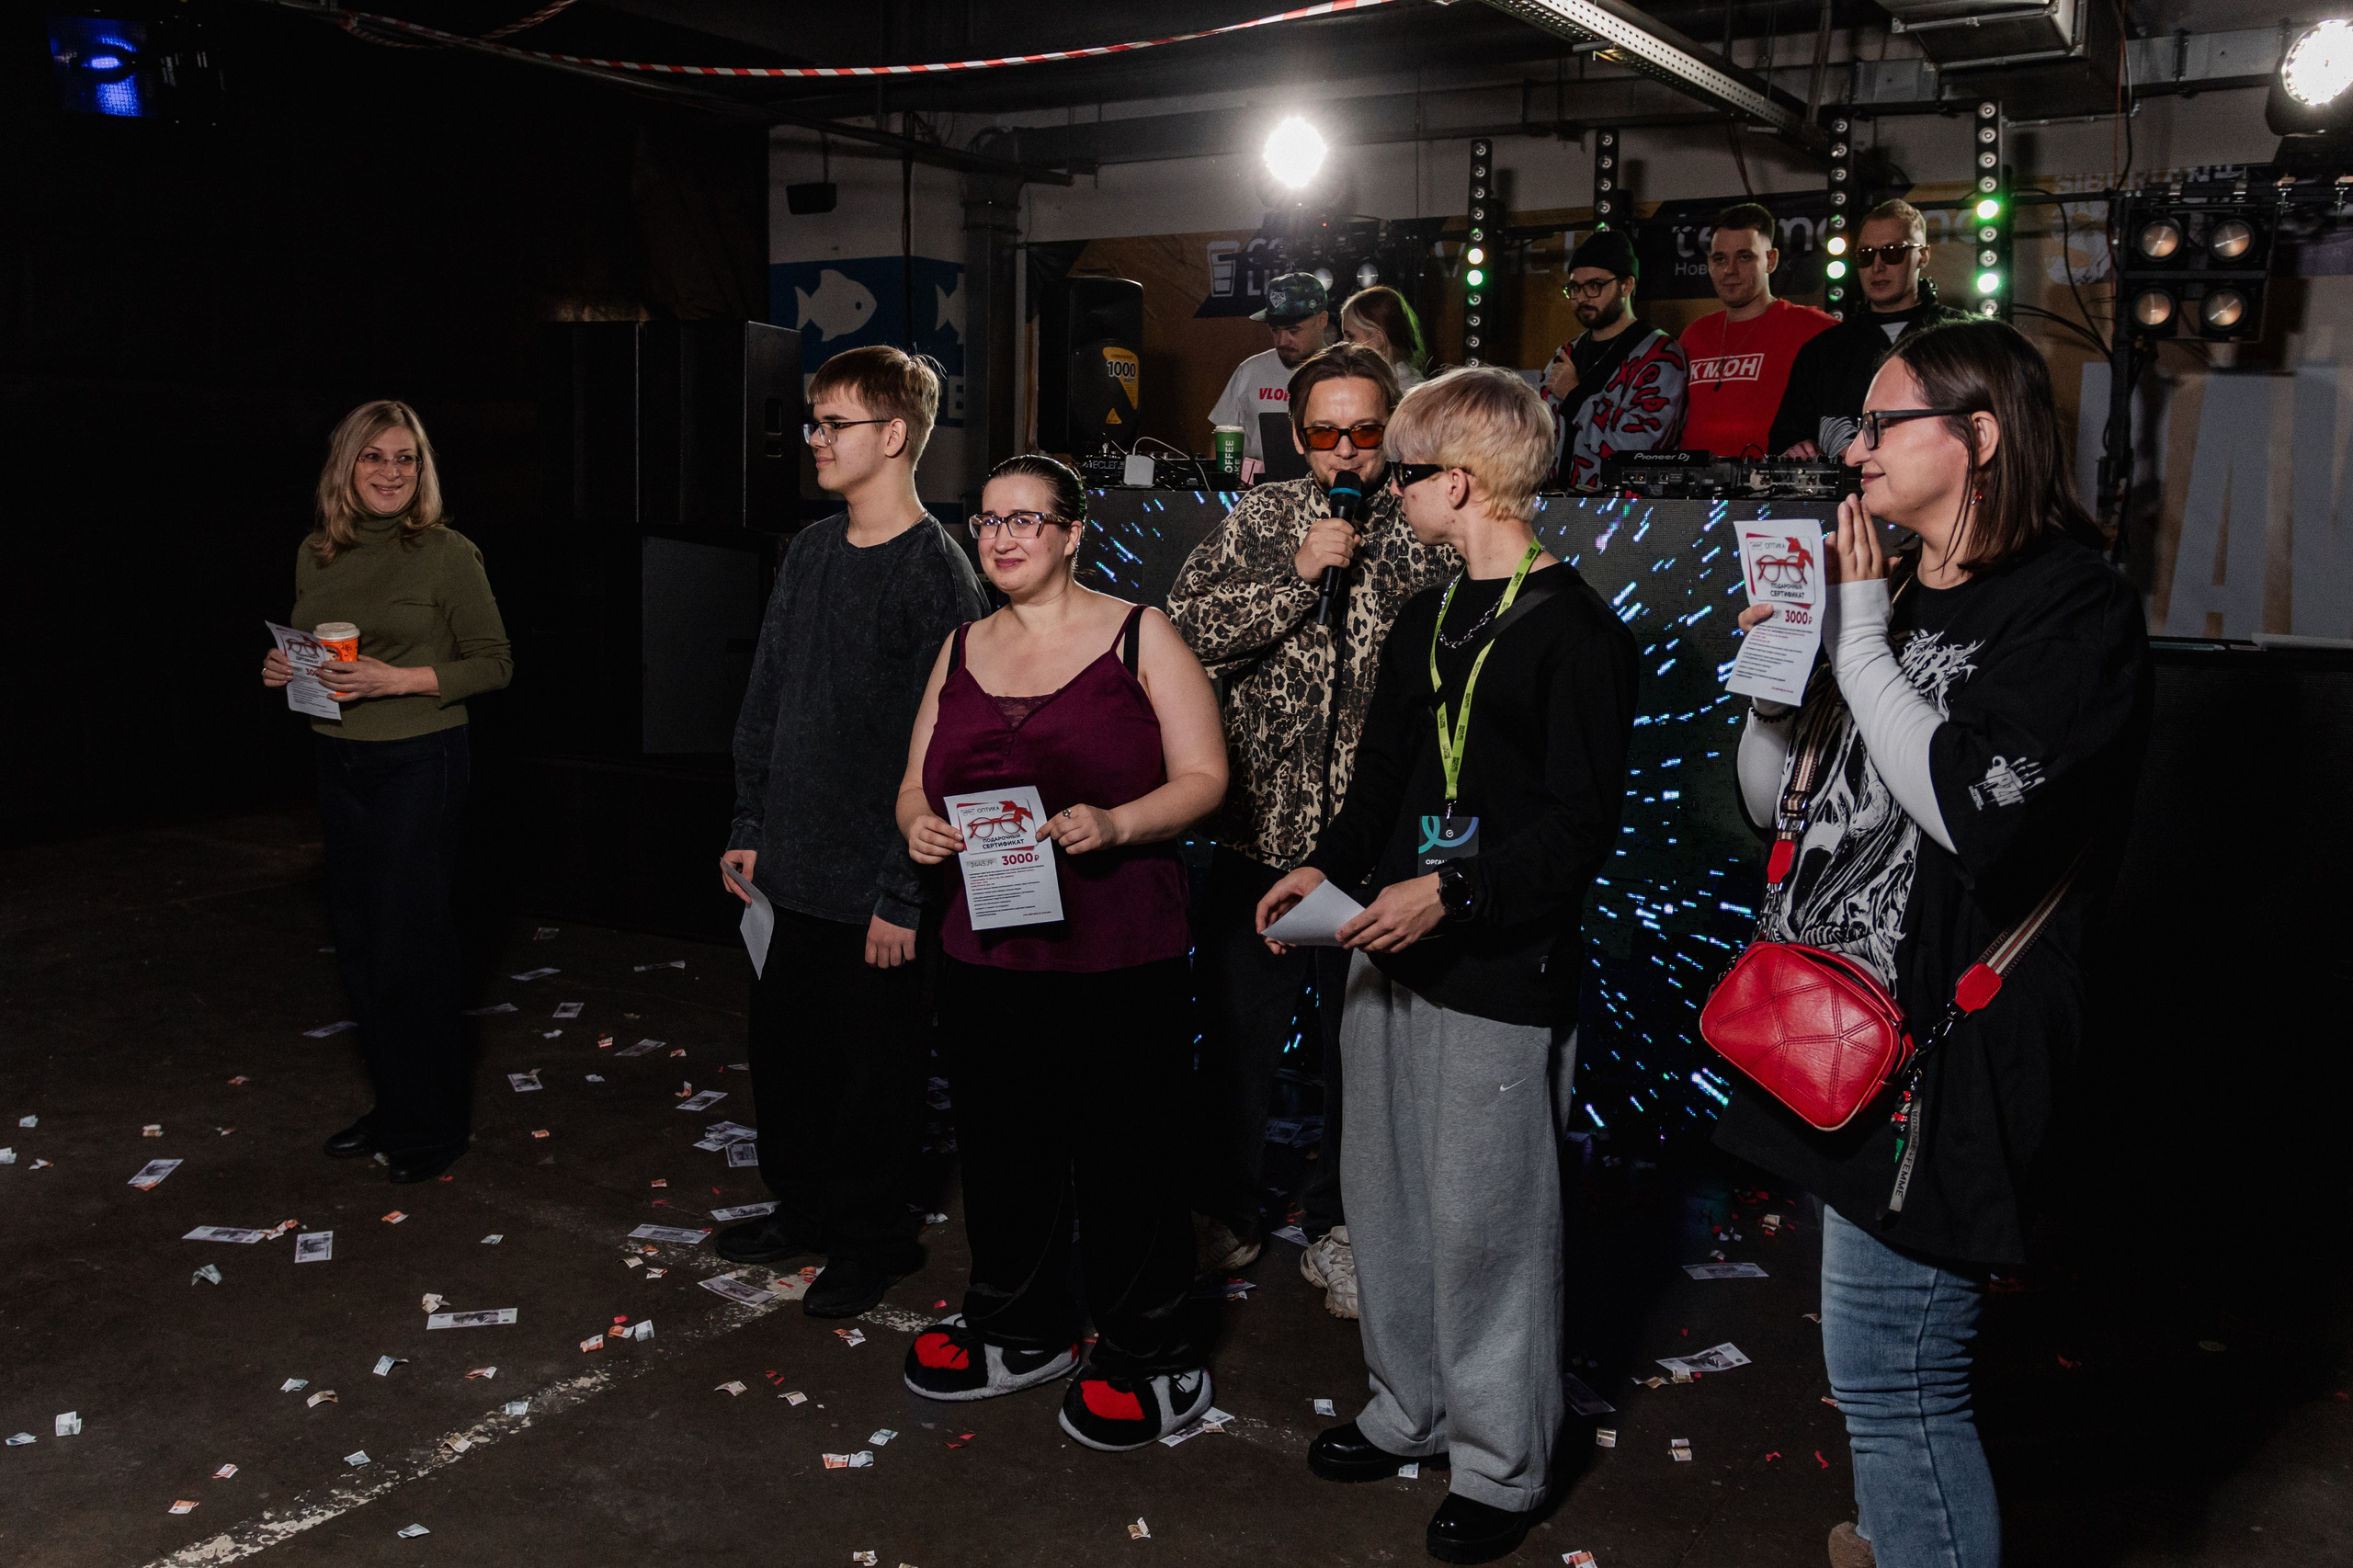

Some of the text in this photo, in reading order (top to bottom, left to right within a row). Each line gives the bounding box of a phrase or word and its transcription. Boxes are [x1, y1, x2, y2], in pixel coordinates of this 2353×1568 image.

[1107, 360, 1136, 378] 1000
[1224, 440, 1234, 473] OFFEE
[1634, 452, 1677, 460] Pioneer
[1770, 582, 1803, 590] ПОДАРОЧНЫЙ
[1770, 590, 1805, 599] СЕРТИФИКАТ
[977, 805, 1000, 813] ОПТИКА
[983, 834, 1021, 843] ПОДАРОЧНЫЙ
[983, 838, 1025, 849] СЕРТИФИКАТ
